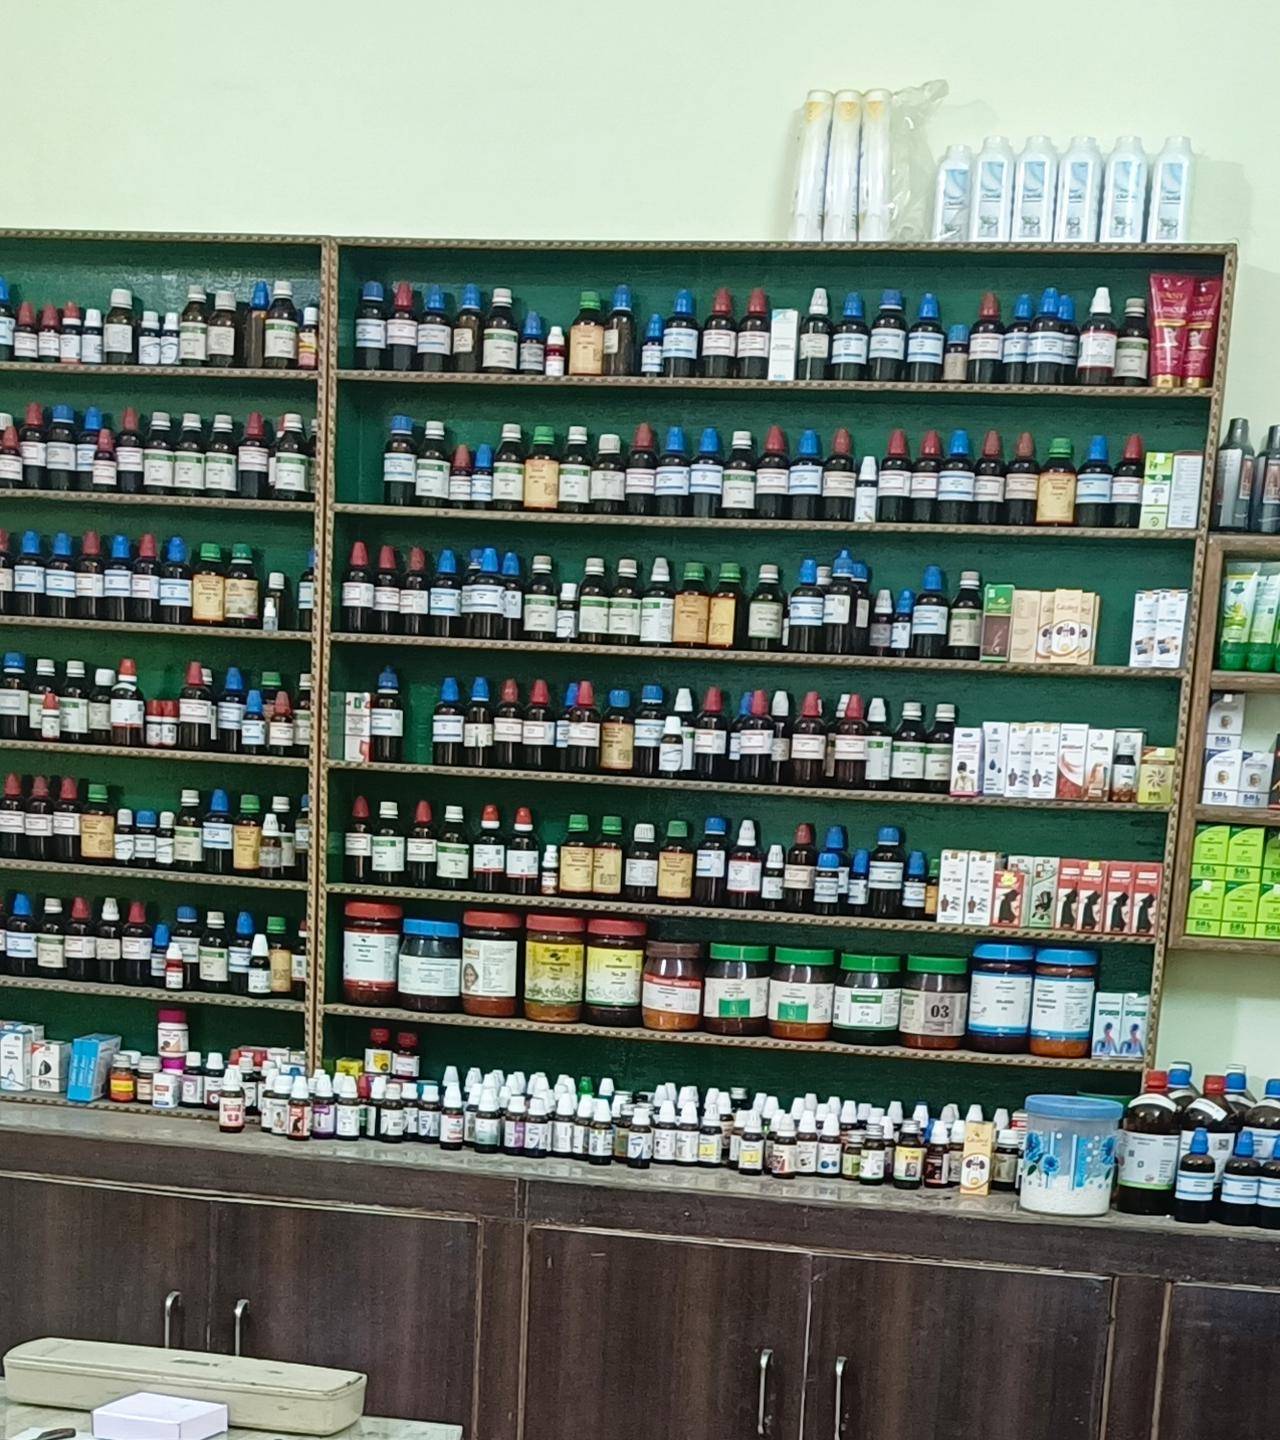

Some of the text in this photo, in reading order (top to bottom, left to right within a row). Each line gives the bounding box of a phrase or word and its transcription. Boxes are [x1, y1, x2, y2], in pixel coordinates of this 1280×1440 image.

[1214, 735, 1231, 743] SBL
[1243, 793, 1261, 801] SBL
[1200, 865, 1216, 873] SBL
[1234, 868, 1250, 876] SBL
[1195, 921, 1211, 929] SBL
[1230, 923, 1246, 931] SBL
[1265, 925, 1280, 933] SBL
[930, 1005, 949, 1018] 03
